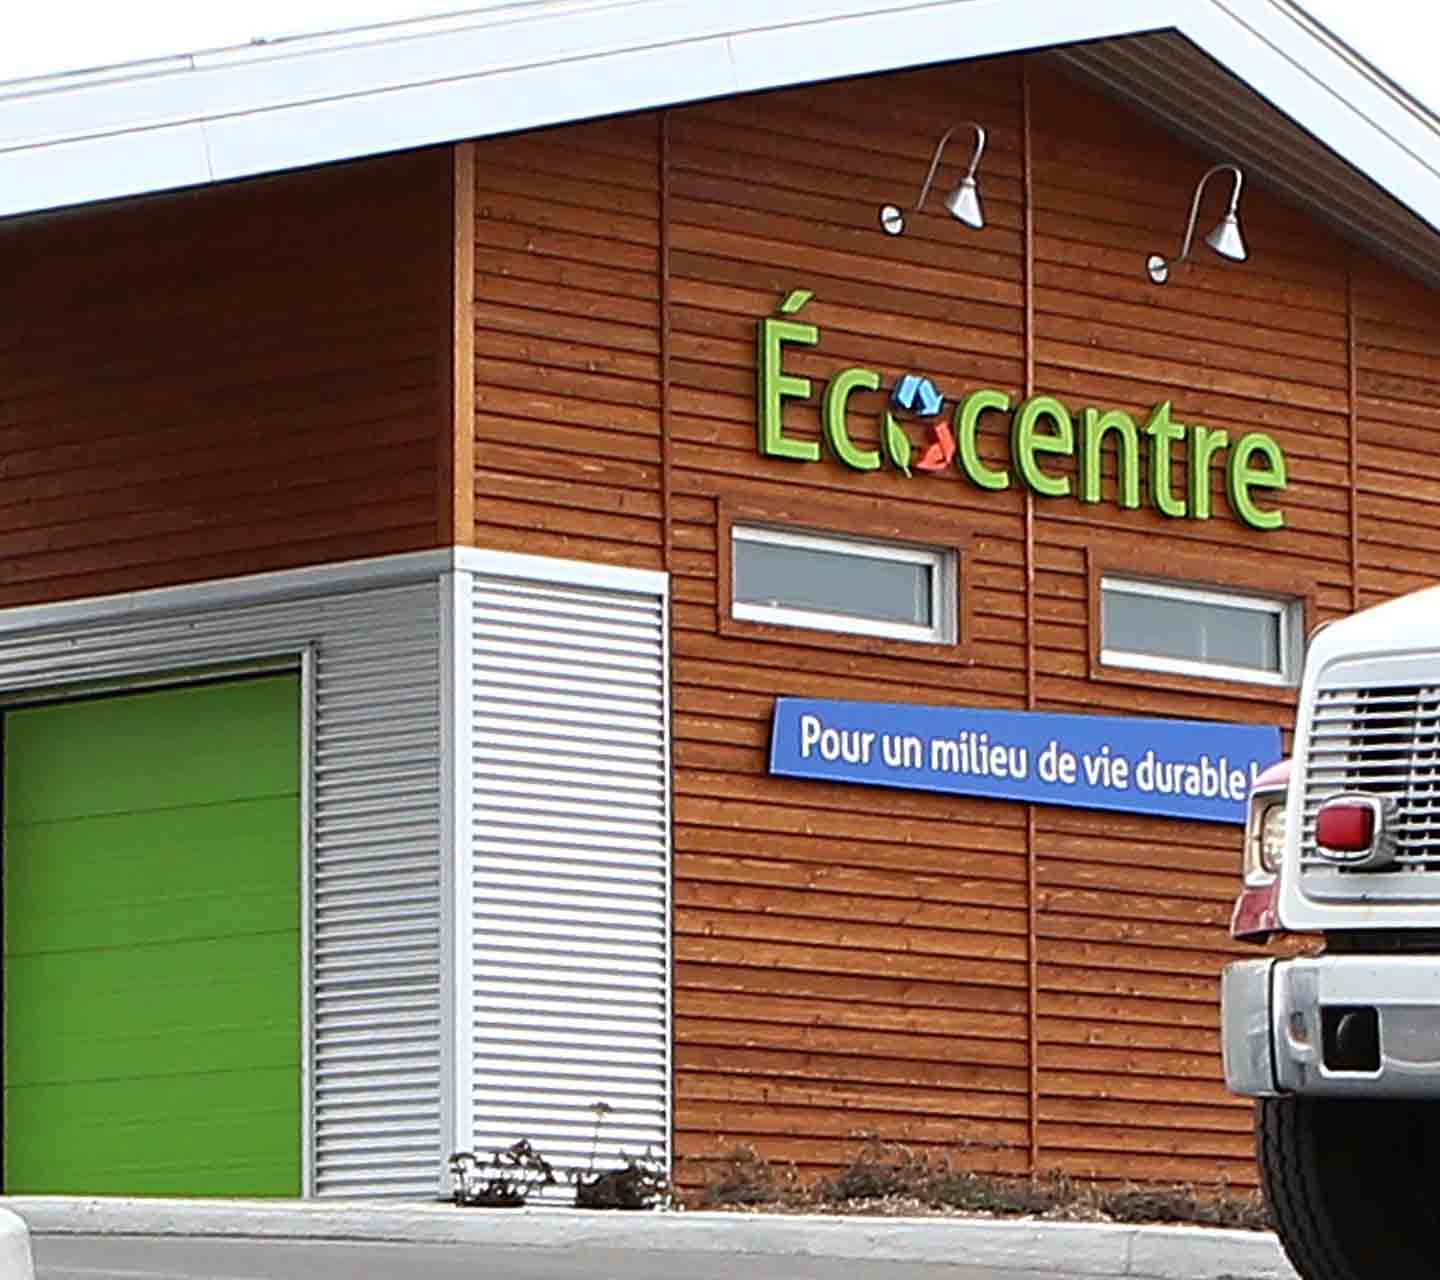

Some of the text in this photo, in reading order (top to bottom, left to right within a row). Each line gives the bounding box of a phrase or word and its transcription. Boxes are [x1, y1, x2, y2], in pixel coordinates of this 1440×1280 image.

[801, 715, 875, 765] Pour
[883, 733, 922, 769] un
[931, 732, 1028, 779] milieu
[1039, 741, 1076, 784] de
[1083, 746, 1128, 790] vie
